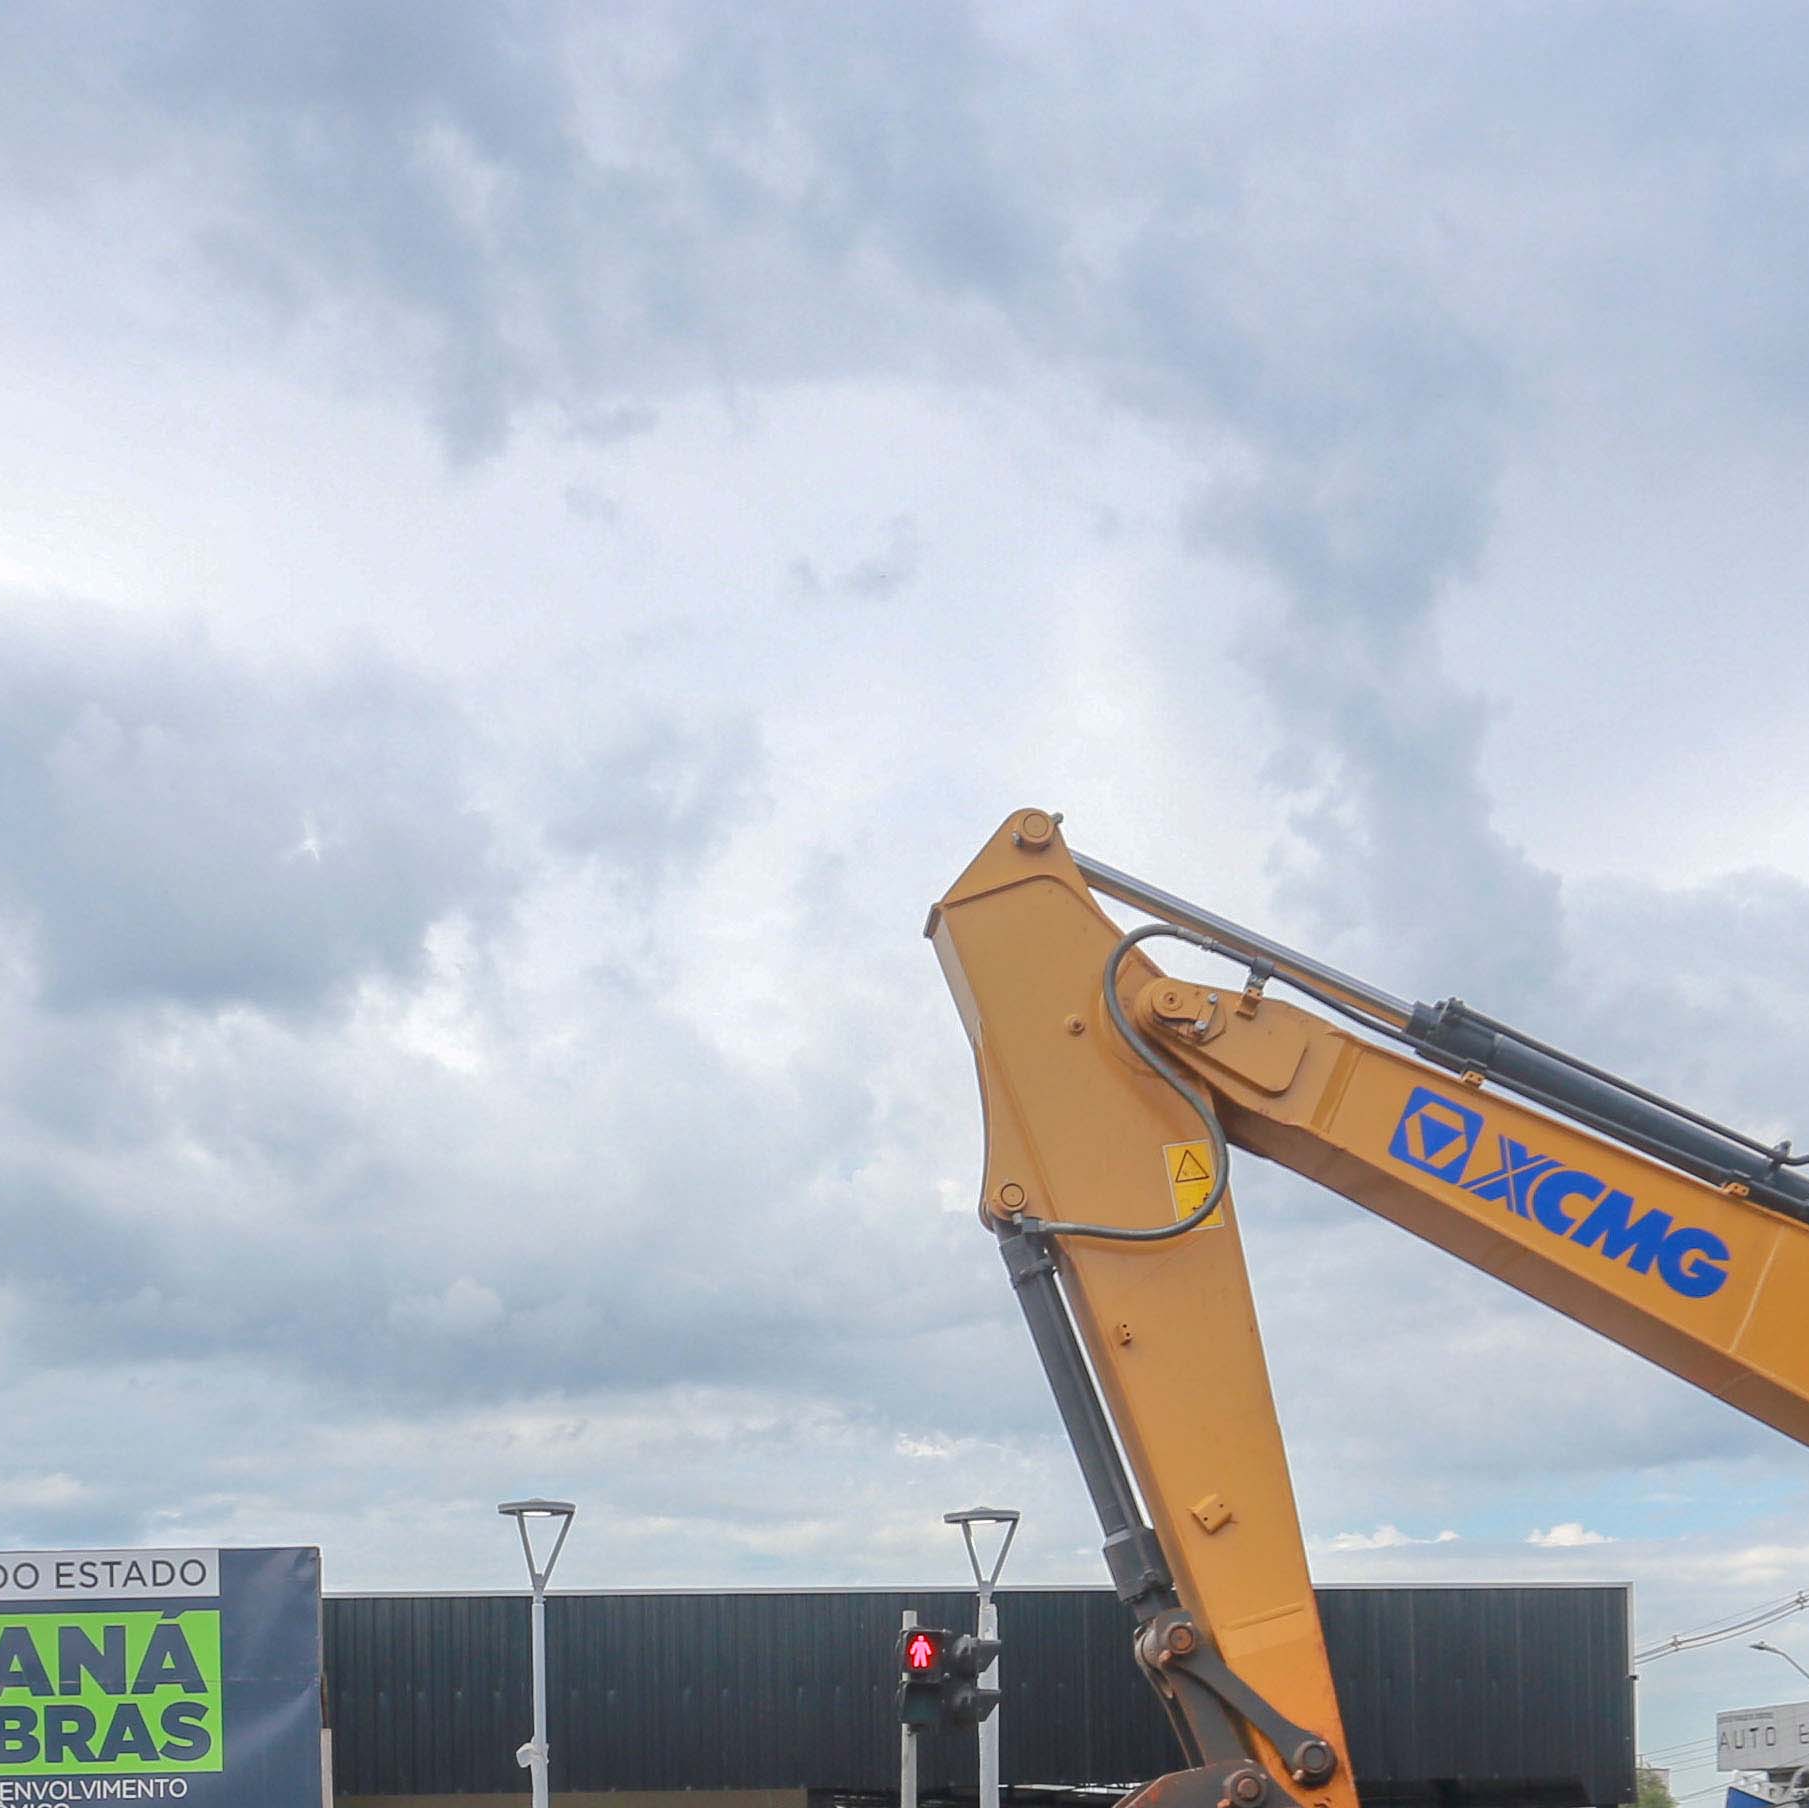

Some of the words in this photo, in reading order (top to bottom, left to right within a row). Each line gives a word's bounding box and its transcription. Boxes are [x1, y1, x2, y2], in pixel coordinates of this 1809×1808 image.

[1460, 1135, 1730, 1298] XCMG
[55, 1559, 207, 1589] ESTADO
[1720, 1726, 1776, 1750] AUTO
